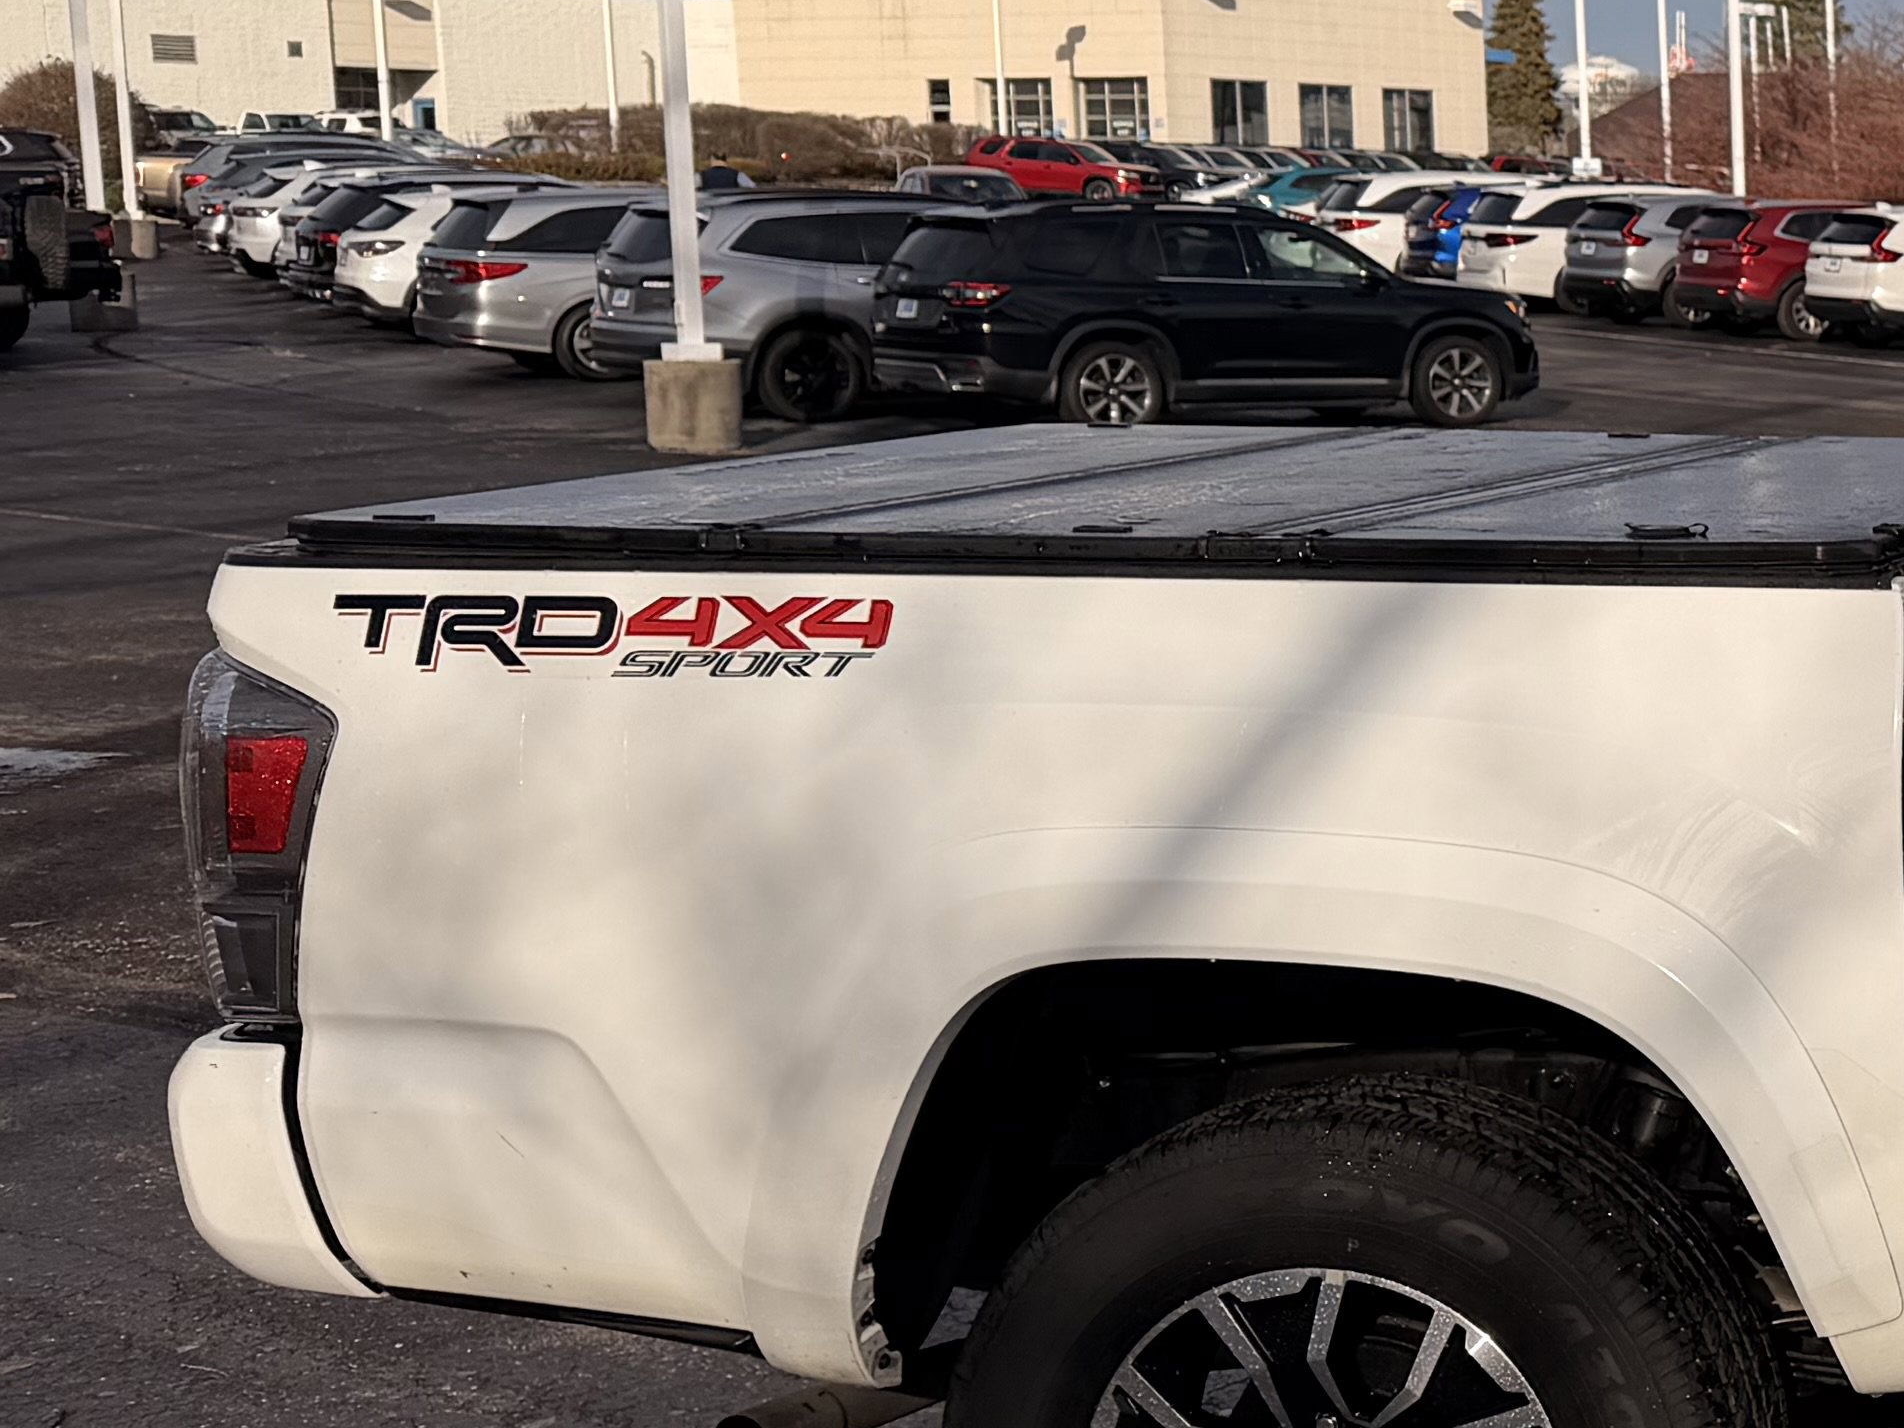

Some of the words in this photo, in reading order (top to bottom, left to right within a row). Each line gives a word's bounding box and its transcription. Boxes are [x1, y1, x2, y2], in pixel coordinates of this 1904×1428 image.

[333, 594, 622, 675] TRD
[625, 596, 894, 650] 4X4
[610, 650, 876, 678] SPORT
[1296, 1177, 1511, 1265] OYO
